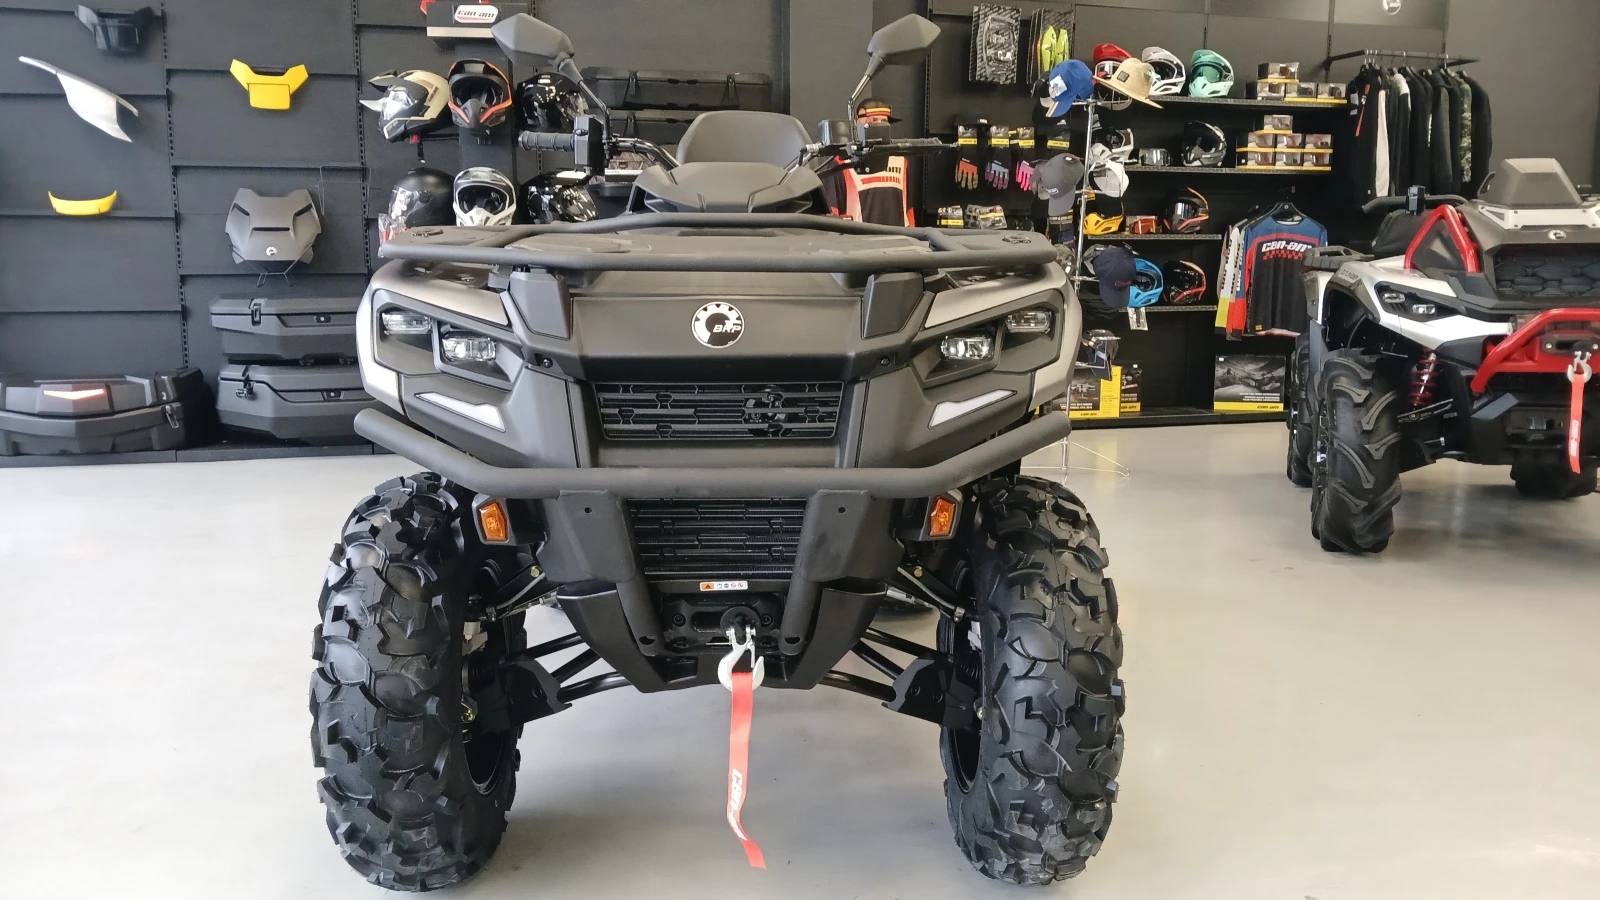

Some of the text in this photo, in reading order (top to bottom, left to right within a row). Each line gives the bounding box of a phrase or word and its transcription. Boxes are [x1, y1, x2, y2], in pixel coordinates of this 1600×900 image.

[458, 10, 495, 18] can-am
[1261, 241, 1312, 252] can-am
[713, 324, 741, 333] BRP
